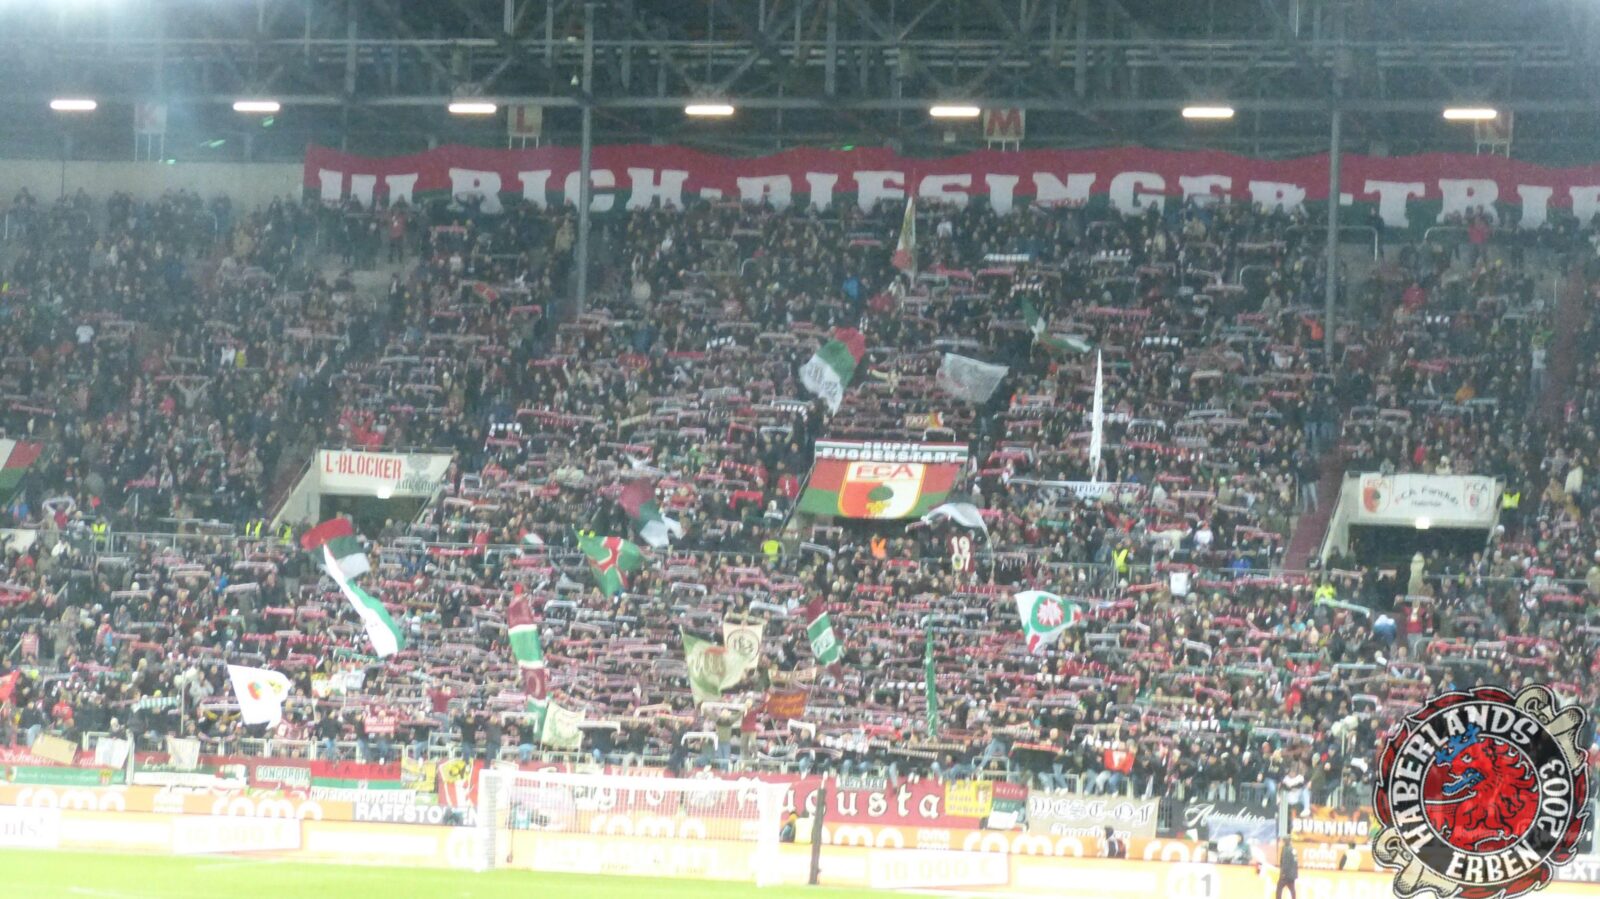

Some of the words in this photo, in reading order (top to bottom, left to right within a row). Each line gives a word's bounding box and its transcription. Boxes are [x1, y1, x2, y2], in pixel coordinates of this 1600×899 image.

[516, 104, 534, 133] L
[987, 107, 1022, 137] M
[856, 464, 914, 479] FCA
